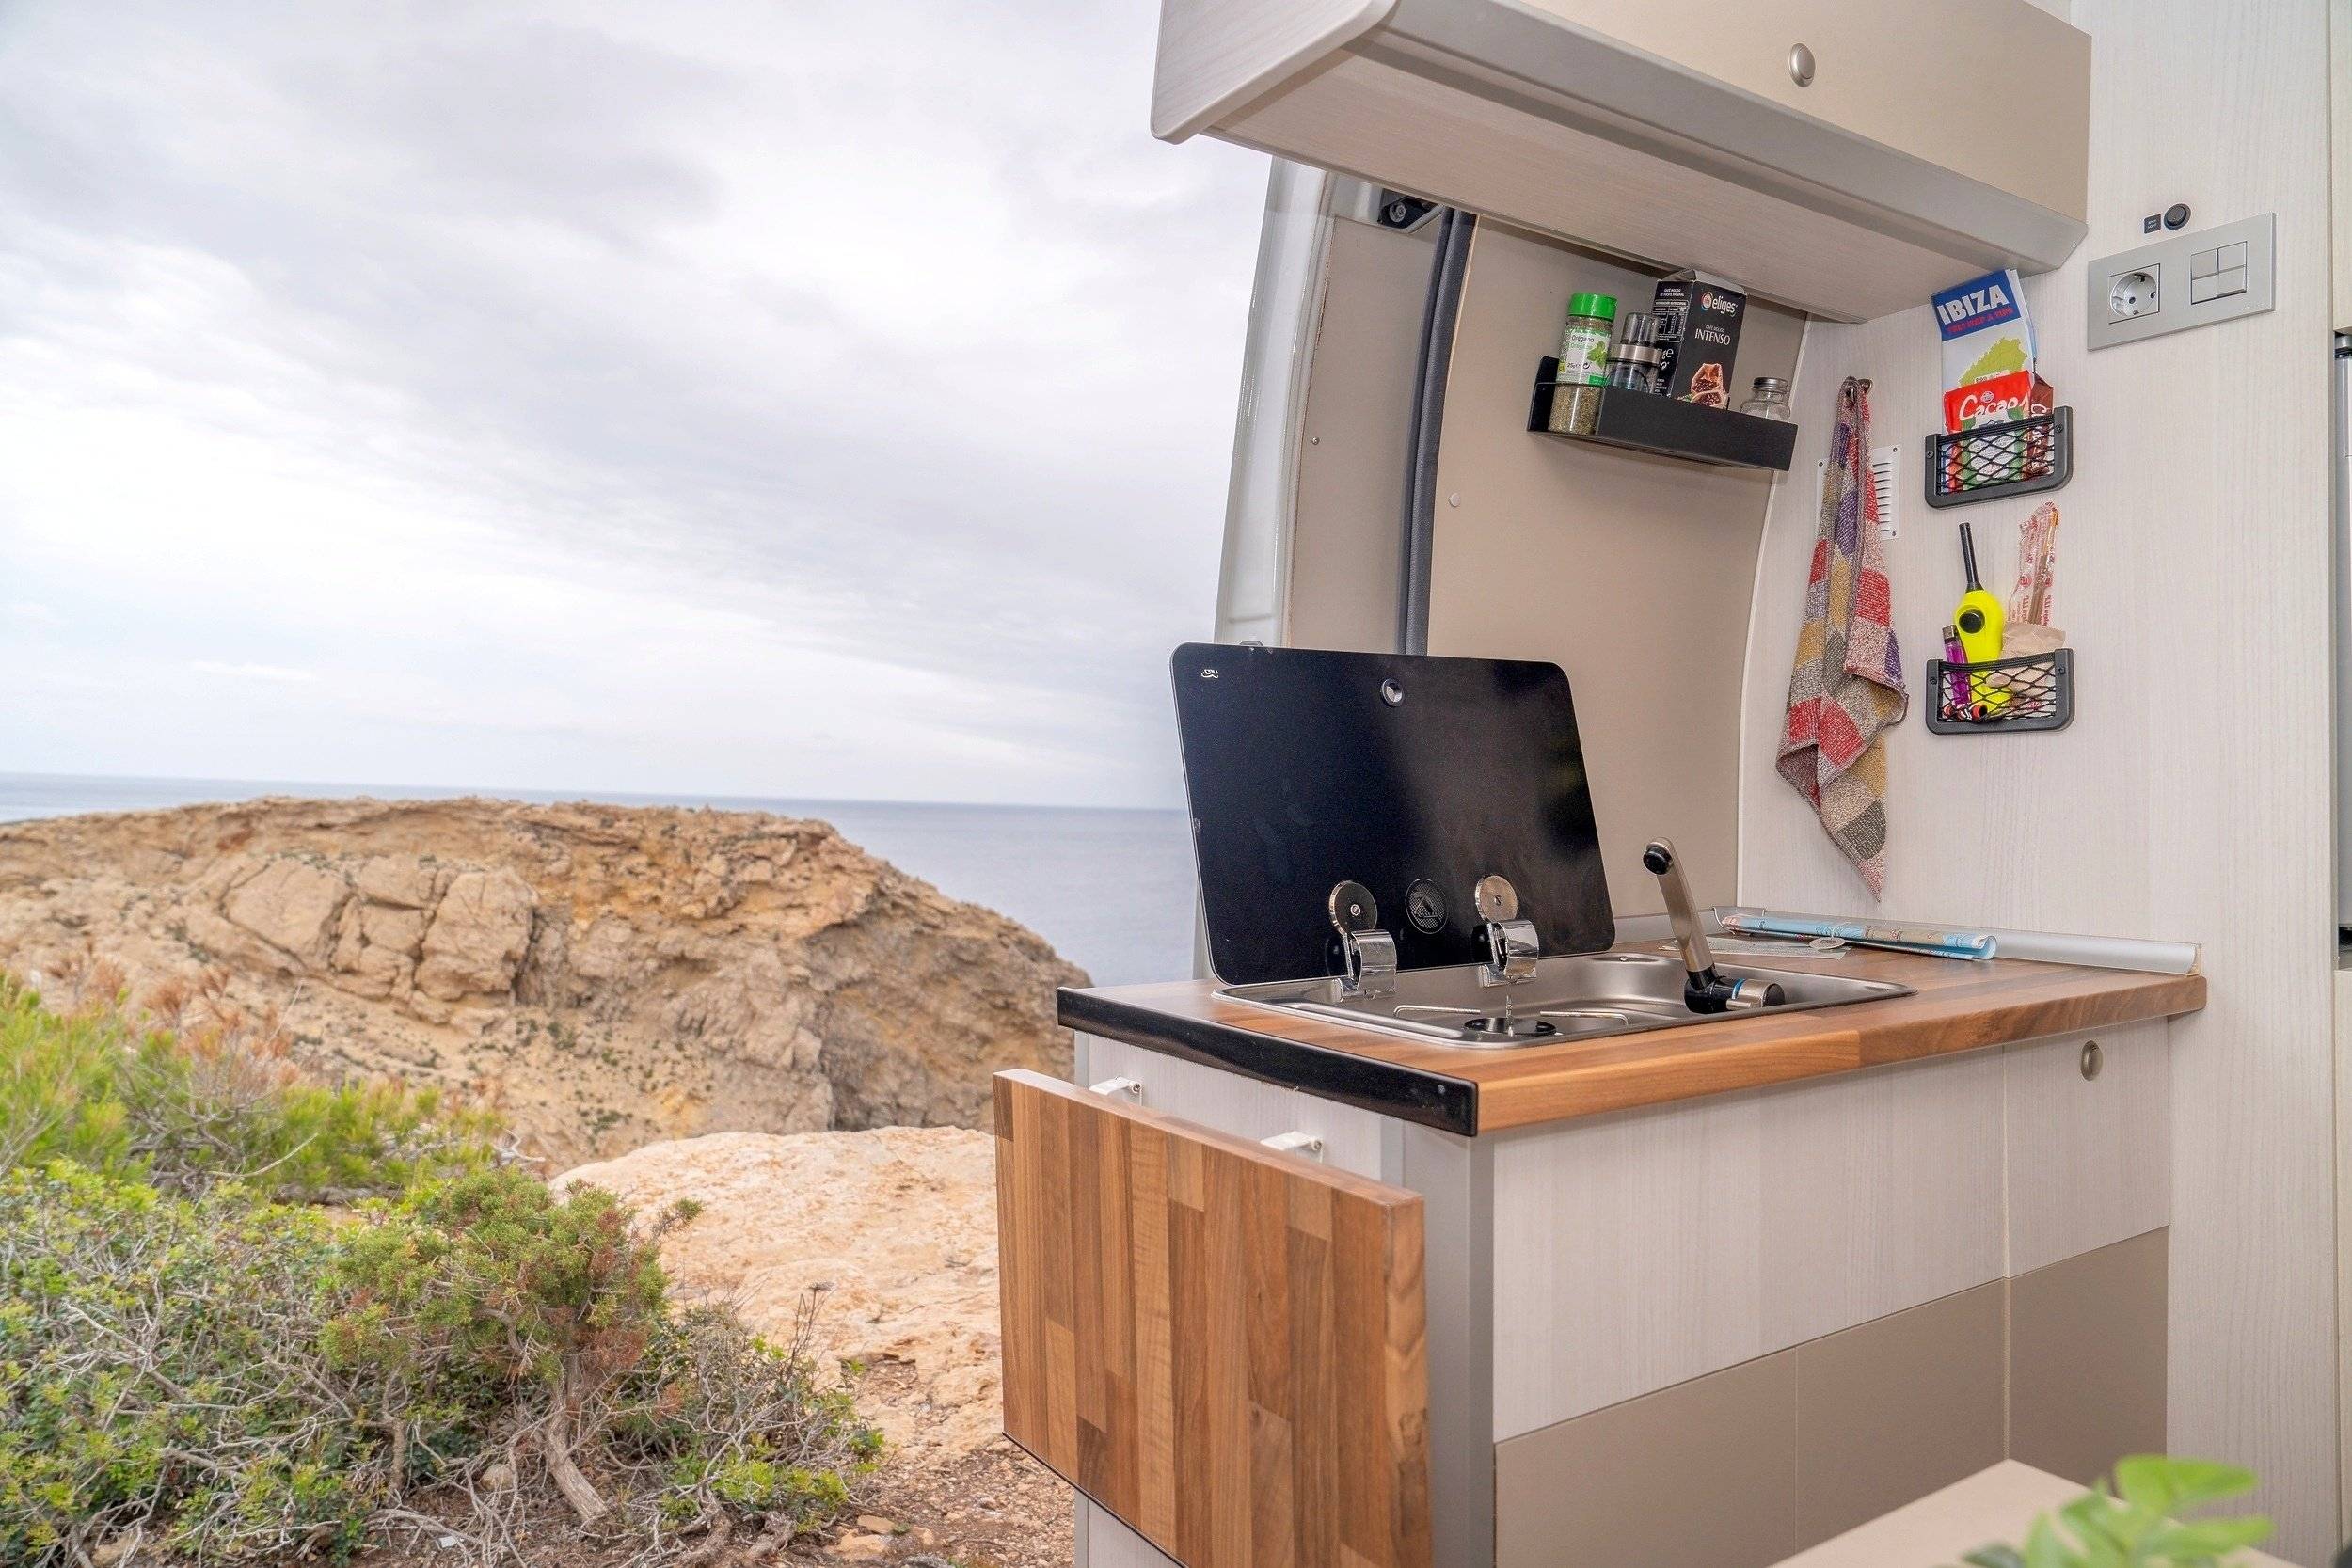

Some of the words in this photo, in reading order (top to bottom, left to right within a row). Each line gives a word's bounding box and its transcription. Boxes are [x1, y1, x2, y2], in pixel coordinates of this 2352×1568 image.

[1712, 295, 1736, 314] eliges
[1937, 284, 2010, 325] IBIZA
[1695, 328, 1731, 345] INTENSO
